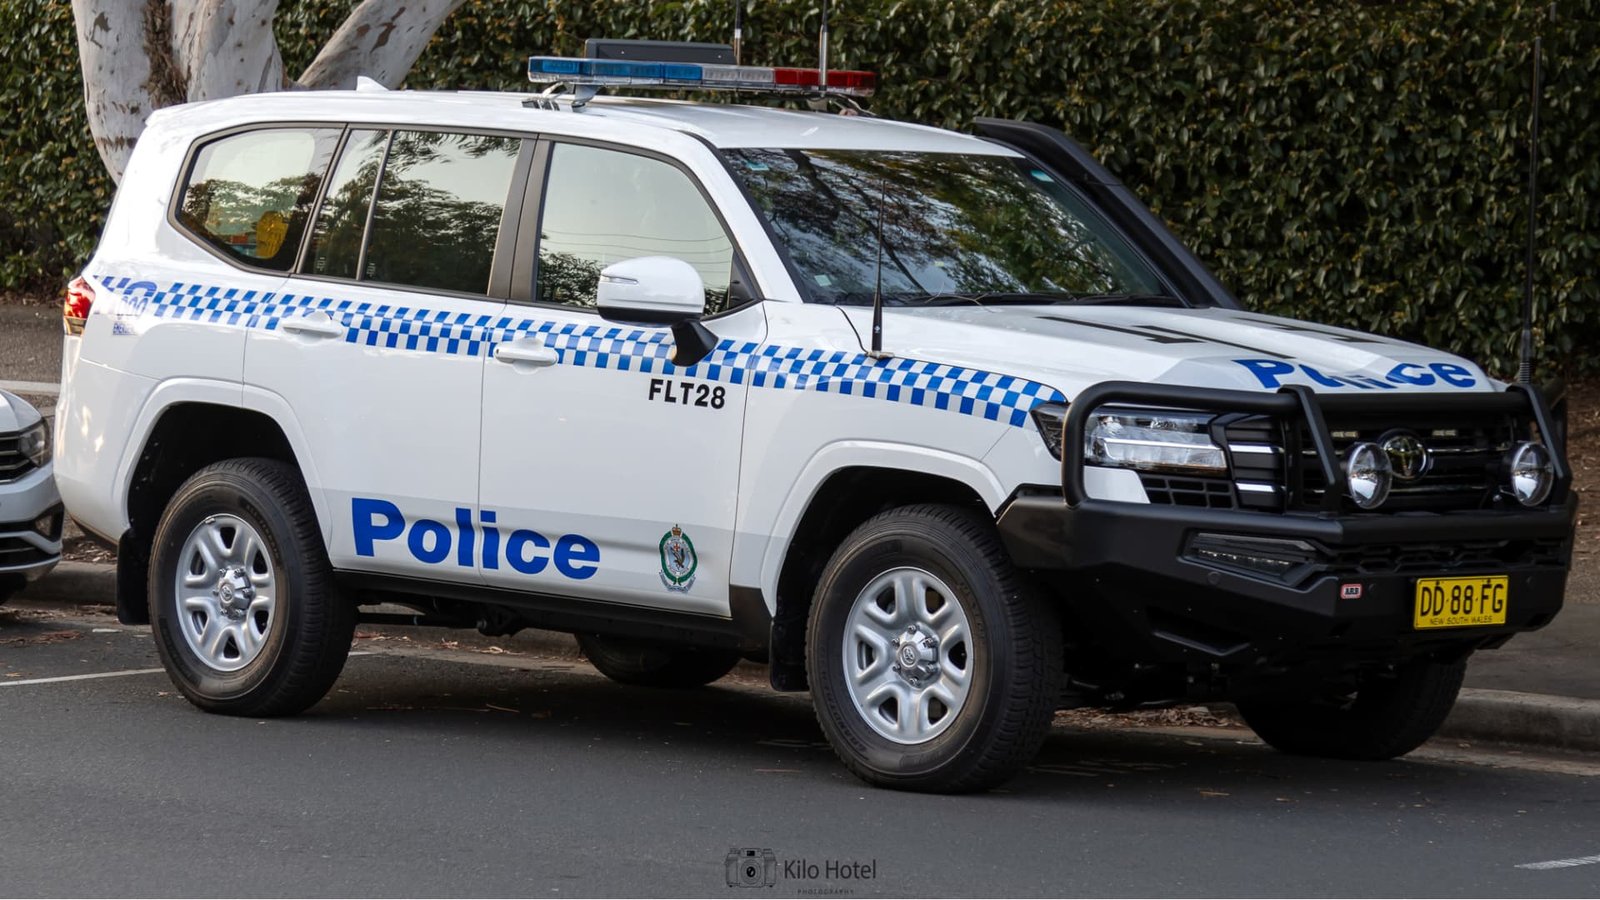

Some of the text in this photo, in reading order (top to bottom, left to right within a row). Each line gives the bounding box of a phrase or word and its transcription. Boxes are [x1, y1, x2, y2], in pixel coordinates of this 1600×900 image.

[648, 378, 726, 410] FLT28
[351, 497, 600, 580] Police
[1430, 615, 1492, 625] NEW SOUTH WALES
